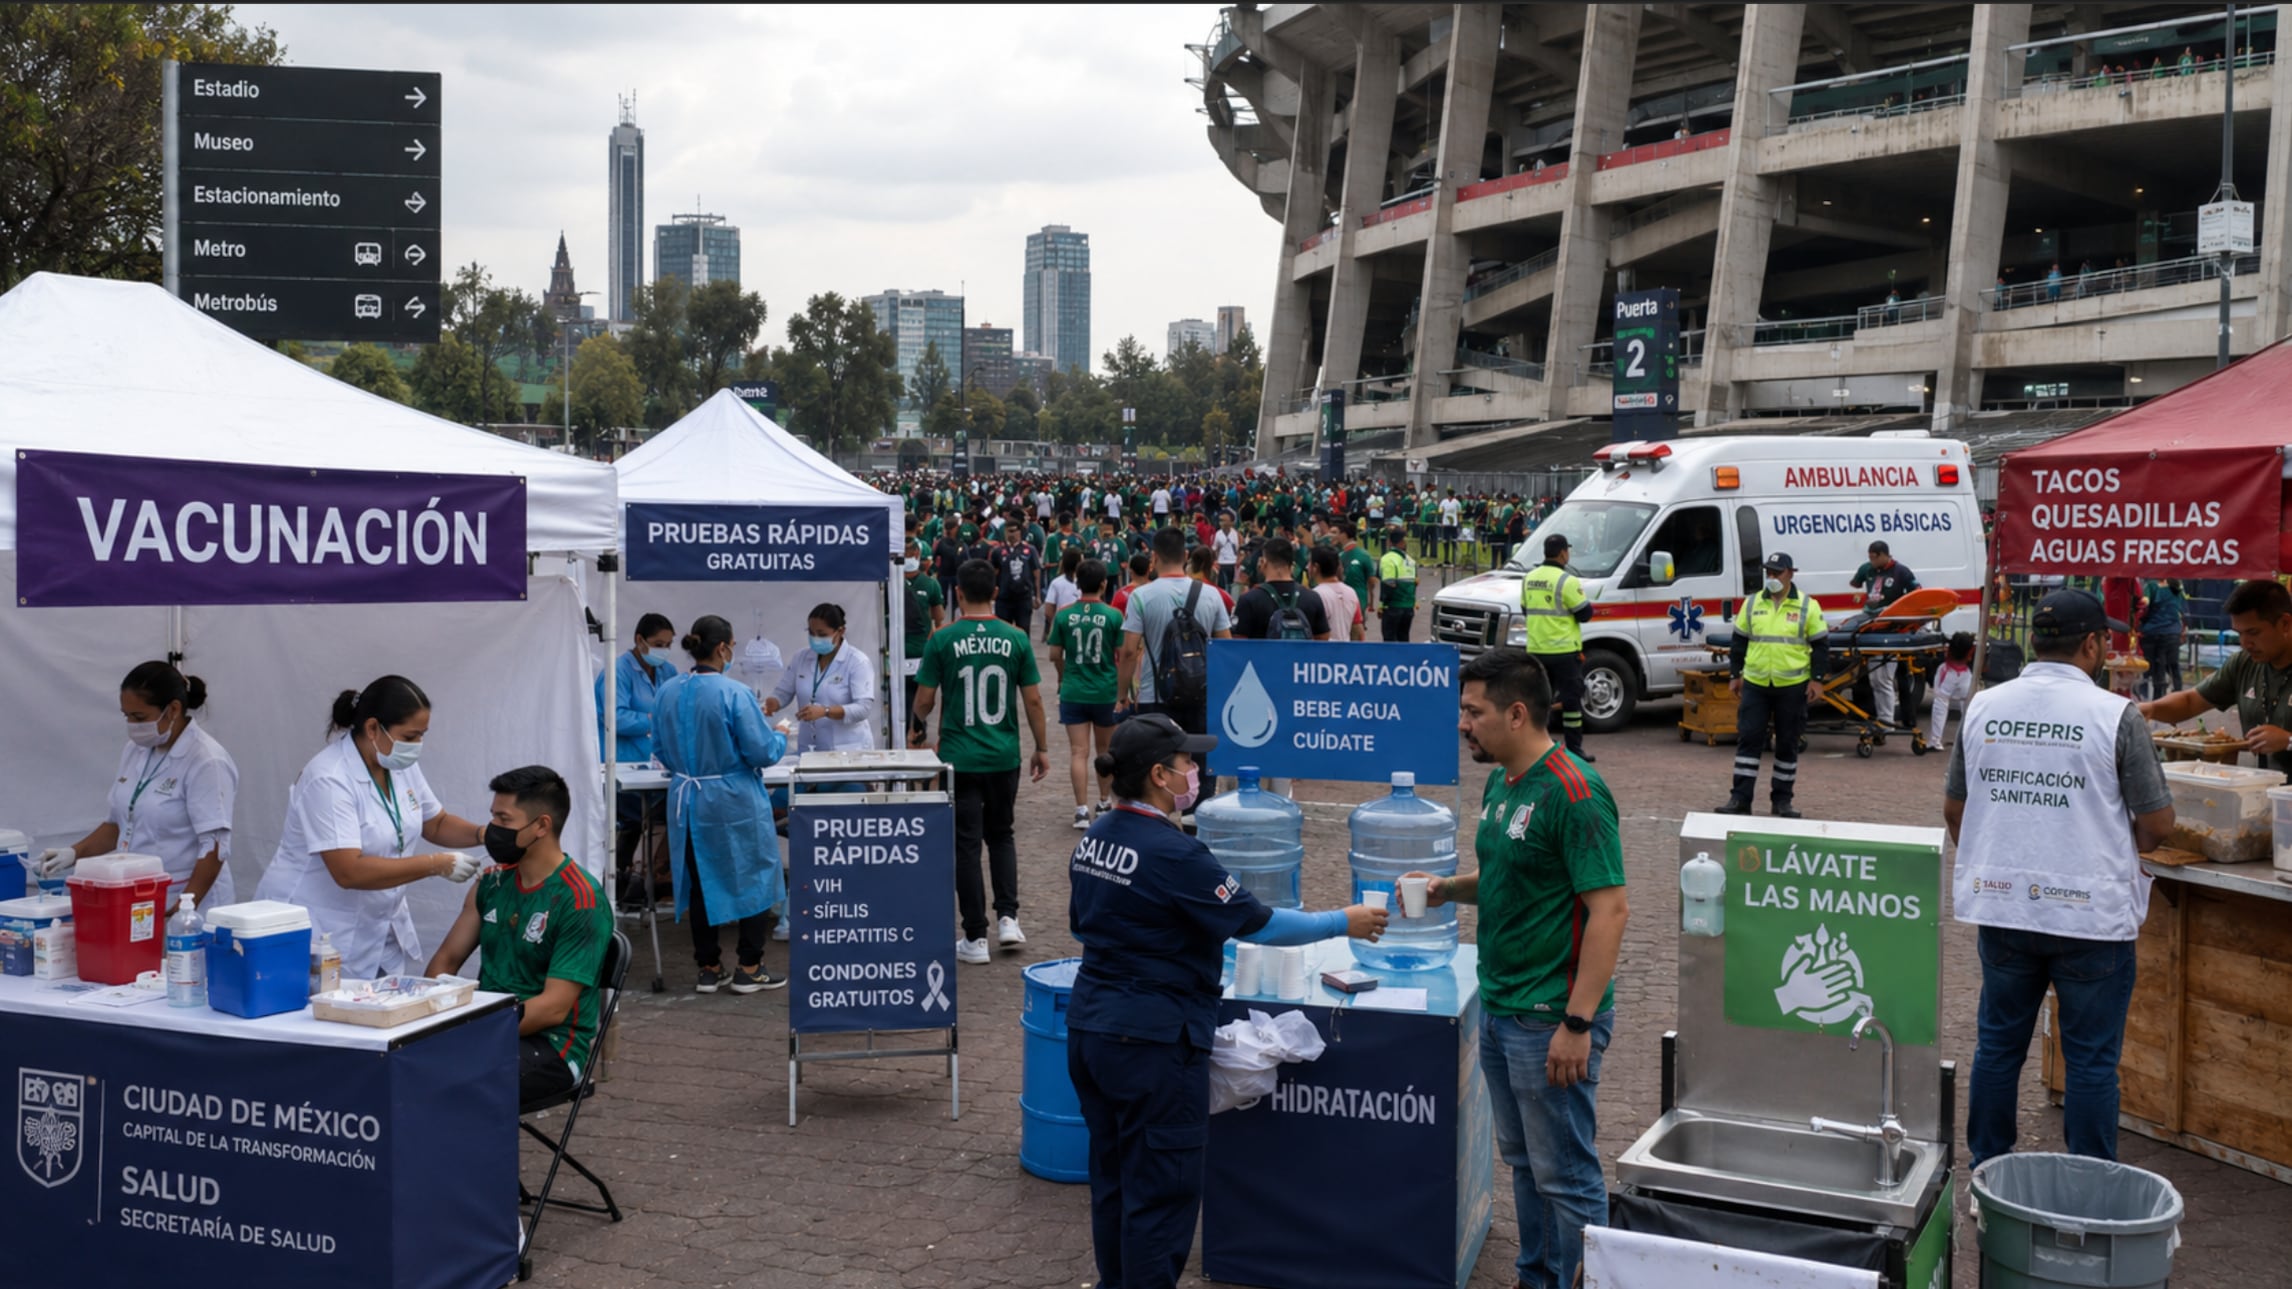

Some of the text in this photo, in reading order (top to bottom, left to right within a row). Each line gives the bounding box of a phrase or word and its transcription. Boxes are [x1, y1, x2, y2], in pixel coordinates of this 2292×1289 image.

[194, 79, 260, 99] Estadio
[194, 132, 254, 152] Museo
[194, 186, 341, 208] Estacionamiento
[194, 239, 246, 258] Metro
[194, 293, 278, 313] Metrobús
[1616, 298, 1658, 319] Puerta
[1626, 339, 1646, 378] 2
[1784, 466, 1920, 489] AMBULANCIA
[2032, 467, 2121, 494] TACOS
[1773, 508, 1952, 536] URGENCIAS BÁSICAS
[2031, 501, 2221, 530] QUESADILLAS
[76, 497, 487, 566] VACUNACIÓN
[648, 518, 870, 546] PRUEBAS RÁPIDAS
[706, 552, 815, 570] GRATUITAS
[2029, 538, 2240, 565] AGUAS FRESCAS
[1293, 659, 1450, 688] HIDRATACIÓN
[958, 664, 1008, 727] 10
[1293, 699, 1401, 721] BEBE AGUA
[1293, 728, 1375, 752] CUÍDATE
[1984, 719, 2084, 741] COFEPRIS
[1978, 767, 2086, 790] VERIFICACIÓN
[1990, 787, 2070, 808] SANITARIA
[813, 816, 925, 839] PRUEBAS
[814, 840, 920, 866] RÁPIDAS
[1075, 836, 1139, 875] SALUD
[1765, 844, 1877, 881] LÁVATE
[813, 878, 842, 893] VIH
[813, 901, 869, 919] SÍFILIS
[1744, 882, 1921, 920] LAS MANOS
[814, 926, 914, 944] HEPATITIS C
[808, 961, 917, 982] CONDONES
[808, 988, 915, 1009] GRATUITOS
[123, 1084, 381, 1143] CIUDAD DE MÉXICO
[122, 1121, 376, 1171] CAPITAL DE LA TRANSFORMACIÓN
[121, 1165, 220, 1206] SALUD
[120, 1207, 336, 1254] SECRETARÍA DE SALUD
